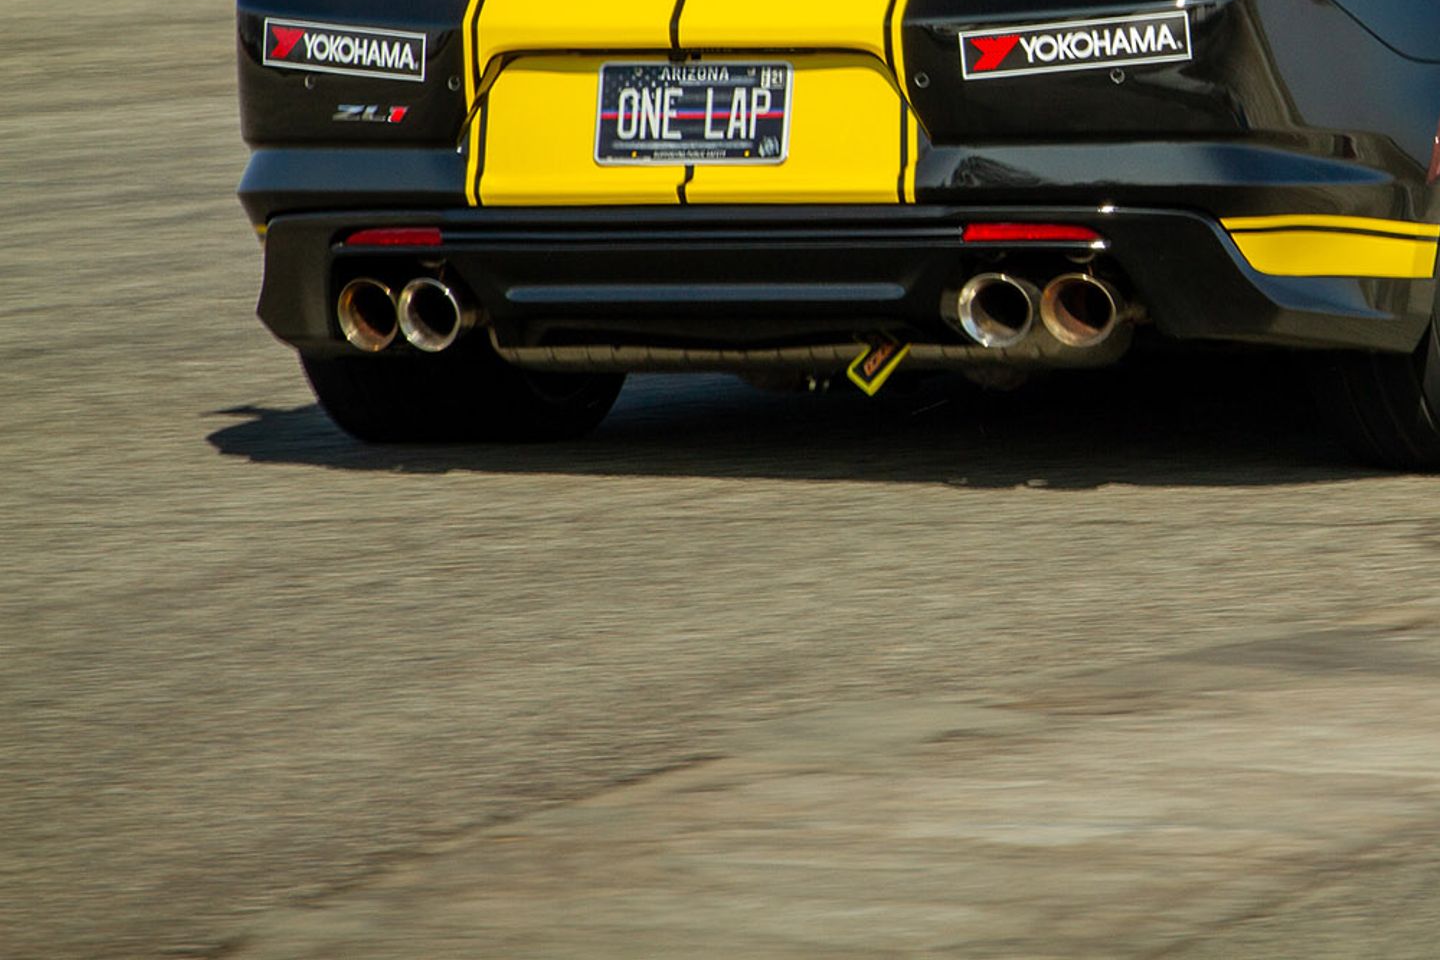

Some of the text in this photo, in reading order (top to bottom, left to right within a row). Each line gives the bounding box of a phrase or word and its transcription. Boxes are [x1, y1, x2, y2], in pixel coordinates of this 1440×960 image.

[303, 32, 419, 70] YOKOHAMA
[1018, 23, 1183, 63] YOKOHAMA
[660, 66, 729, 82] ARIZONA
[332, 104, 408, 123] ZL1
[617, 87, 772, 140] ONE LAP
